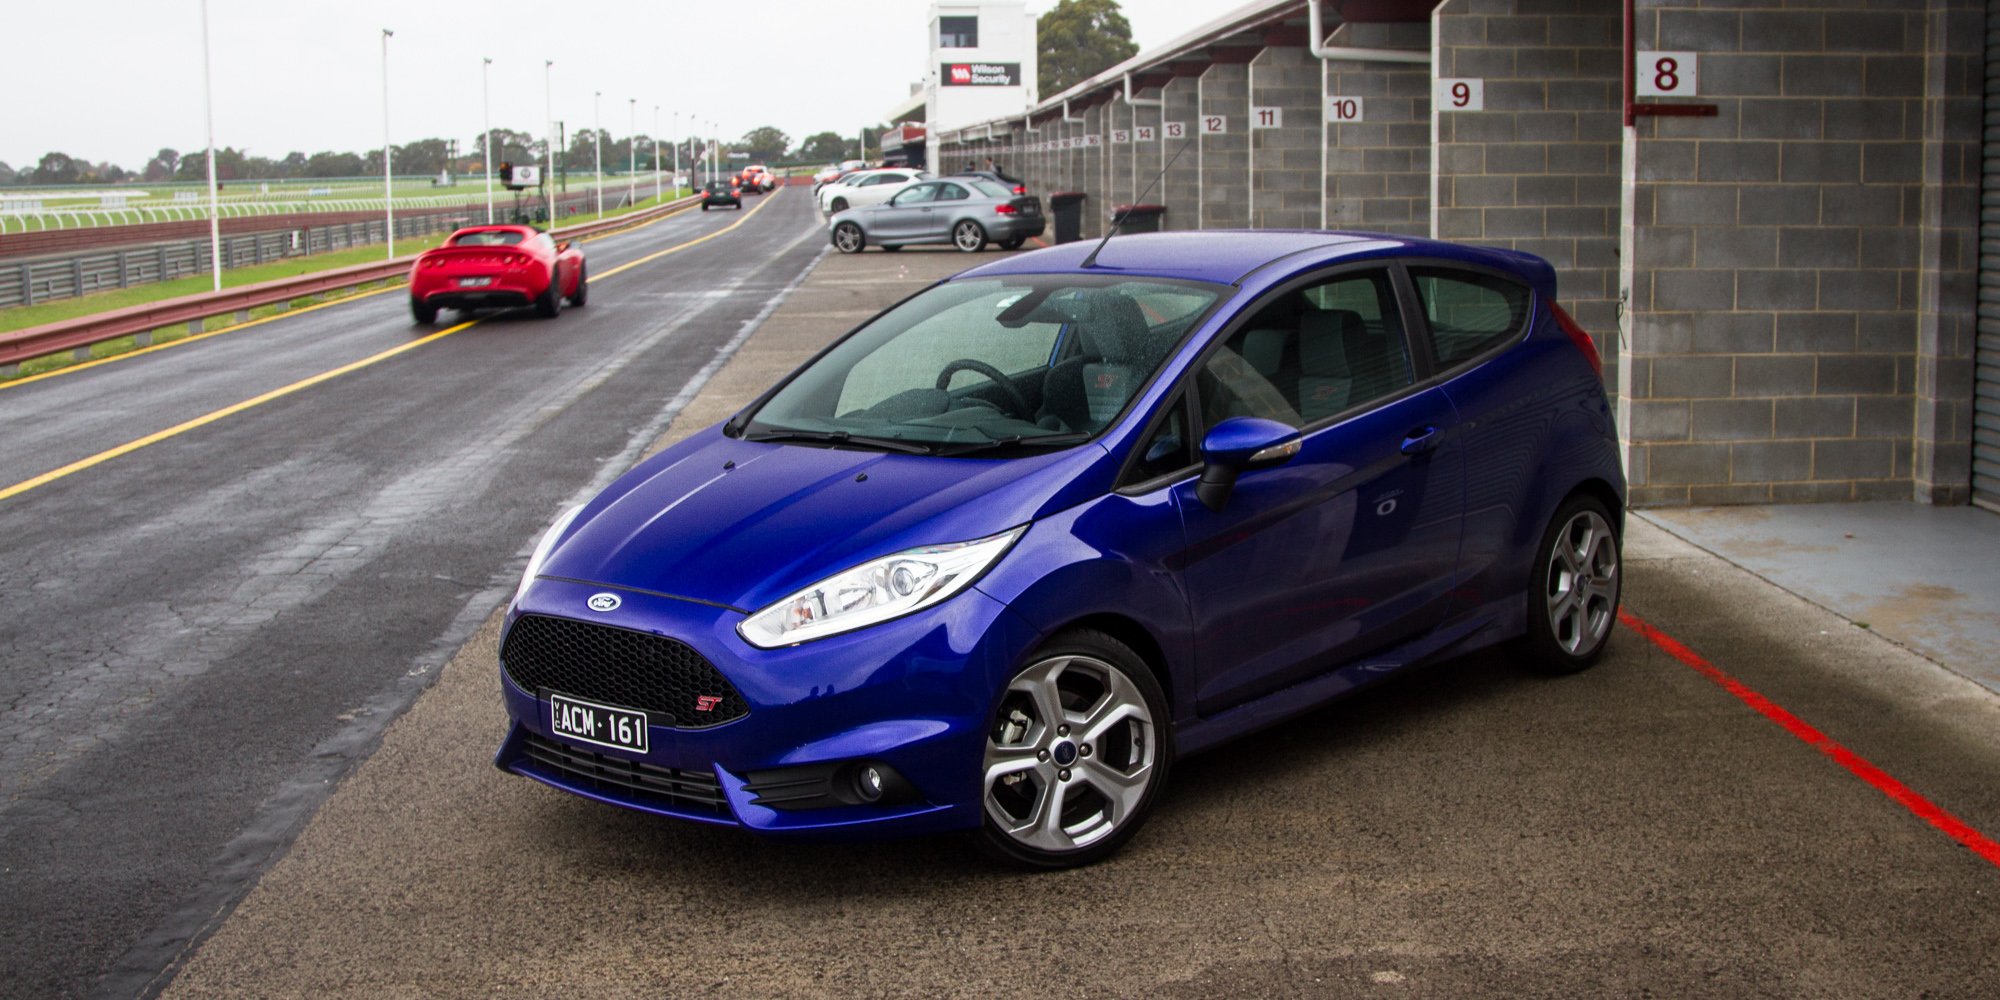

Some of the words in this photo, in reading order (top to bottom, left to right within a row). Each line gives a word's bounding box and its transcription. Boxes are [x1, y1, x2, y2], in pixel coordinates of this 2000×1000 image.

[971, 64, 1005, 73] Wilson
[1655, 57, 1679, 91] 8
[971, 73, 1011, 85] Security
[1452, 82, 1470, 107] 9
[1333, 100, 1357, 119] 10
[1205, 117, 1222, 131] 12
[1258, 109, 1274, 126] 11
[1114, 132, 1126, 141] 15
[1138, 128, 1151, 138] 14
[1166, 124, 1182, 136] 13
[696, 695, 723, 711] ST
